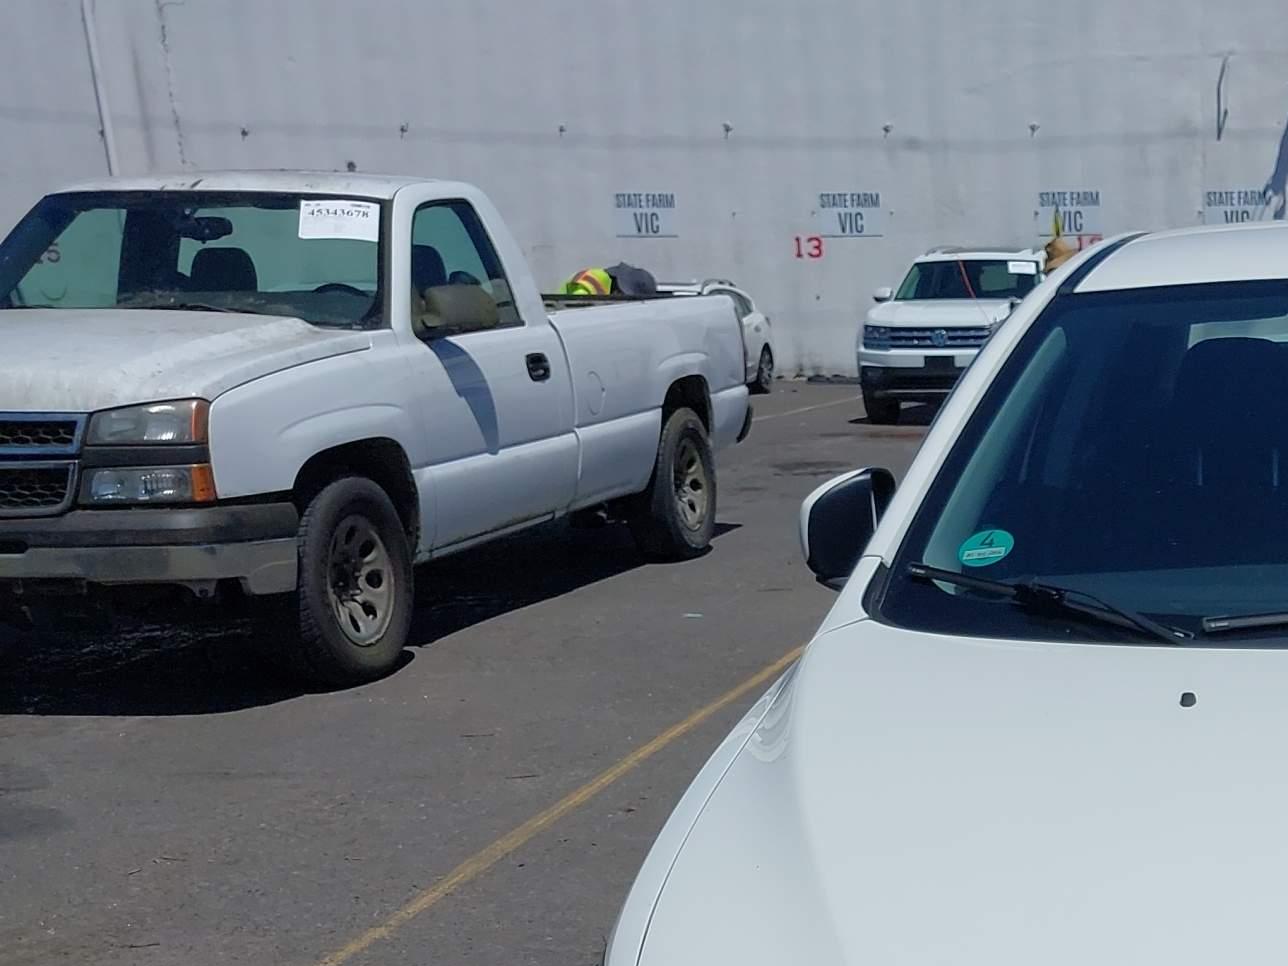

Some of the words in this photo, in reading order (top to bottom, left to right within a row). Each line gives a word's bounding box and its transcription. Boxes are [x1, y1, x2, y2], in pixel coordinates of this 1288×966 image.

[615, 193, 643, 208] STATE
[645, 193, 675, 208] FARM
[820, 193, 848, 208] STATE
[850, 193, 880, 208] FARM
[1039, 191, 1068, 207] STATE
[1070, 191, 1099, 206] FARM
[1206, 191, 1234, 207] STATE
[633, 212, 660, 234] VIC
[837, 212, 865, 234] VIC
[794, 236, 822, 258] 13
